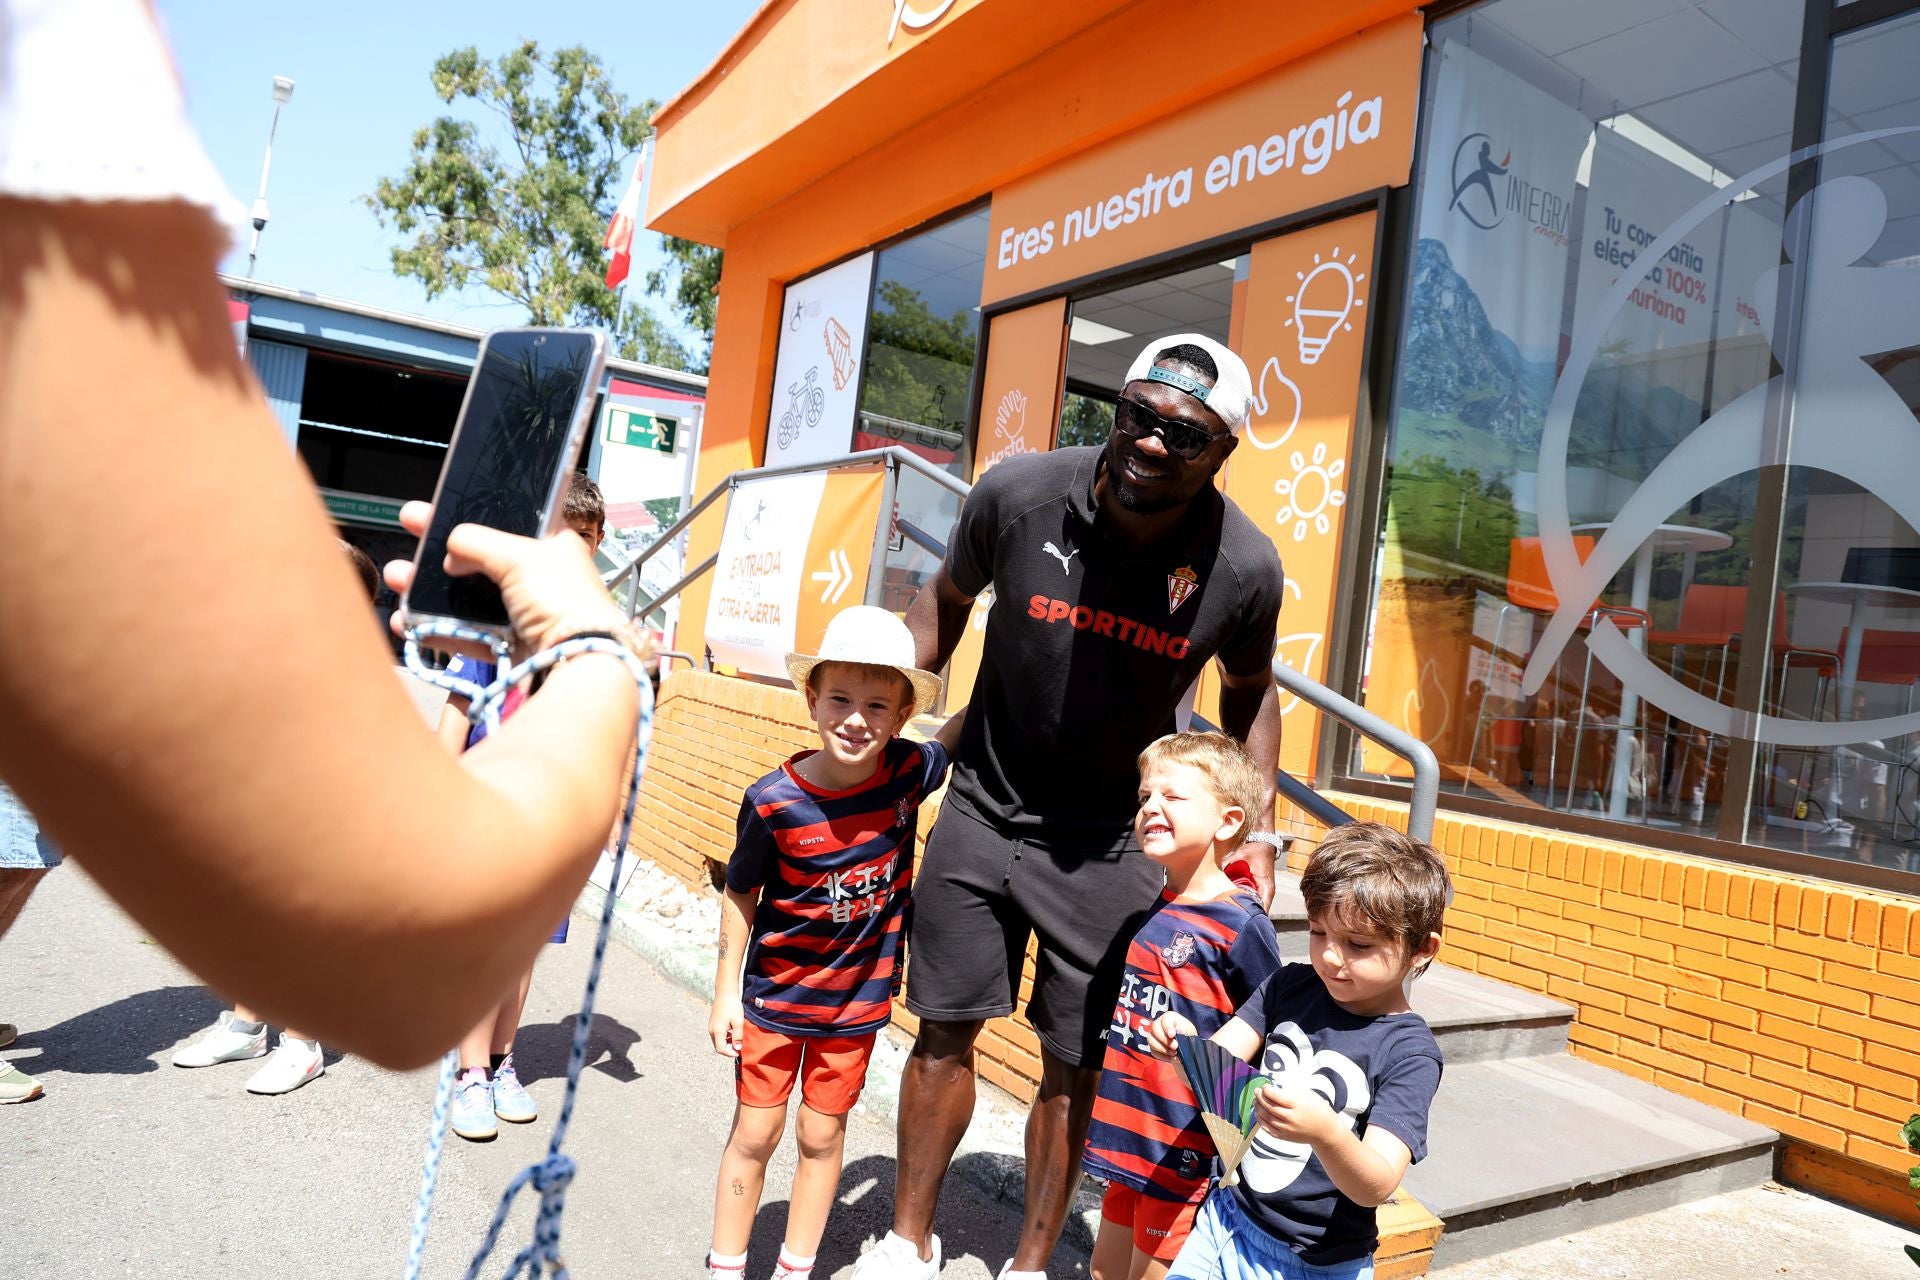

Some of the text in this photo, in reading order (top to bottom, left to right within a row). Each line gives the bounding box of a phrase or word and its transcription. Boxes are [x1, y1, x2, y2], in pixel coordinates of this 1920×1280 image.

[997, 90, 1383, 270] Eres nuestra energía
[1604, 206, 1621, 235] Tu
[1666, 267, 1706, 304] 100%
[730, 550, 781, 579] ENTRADA
[718, 597, 781, 626] OTRA PUERTA
[1027, 594, 1191, 660] SPORTING
[799, 836, 825, 847] KIPSTA
[1146, 1227, 1172, 1238] KIPSTA
